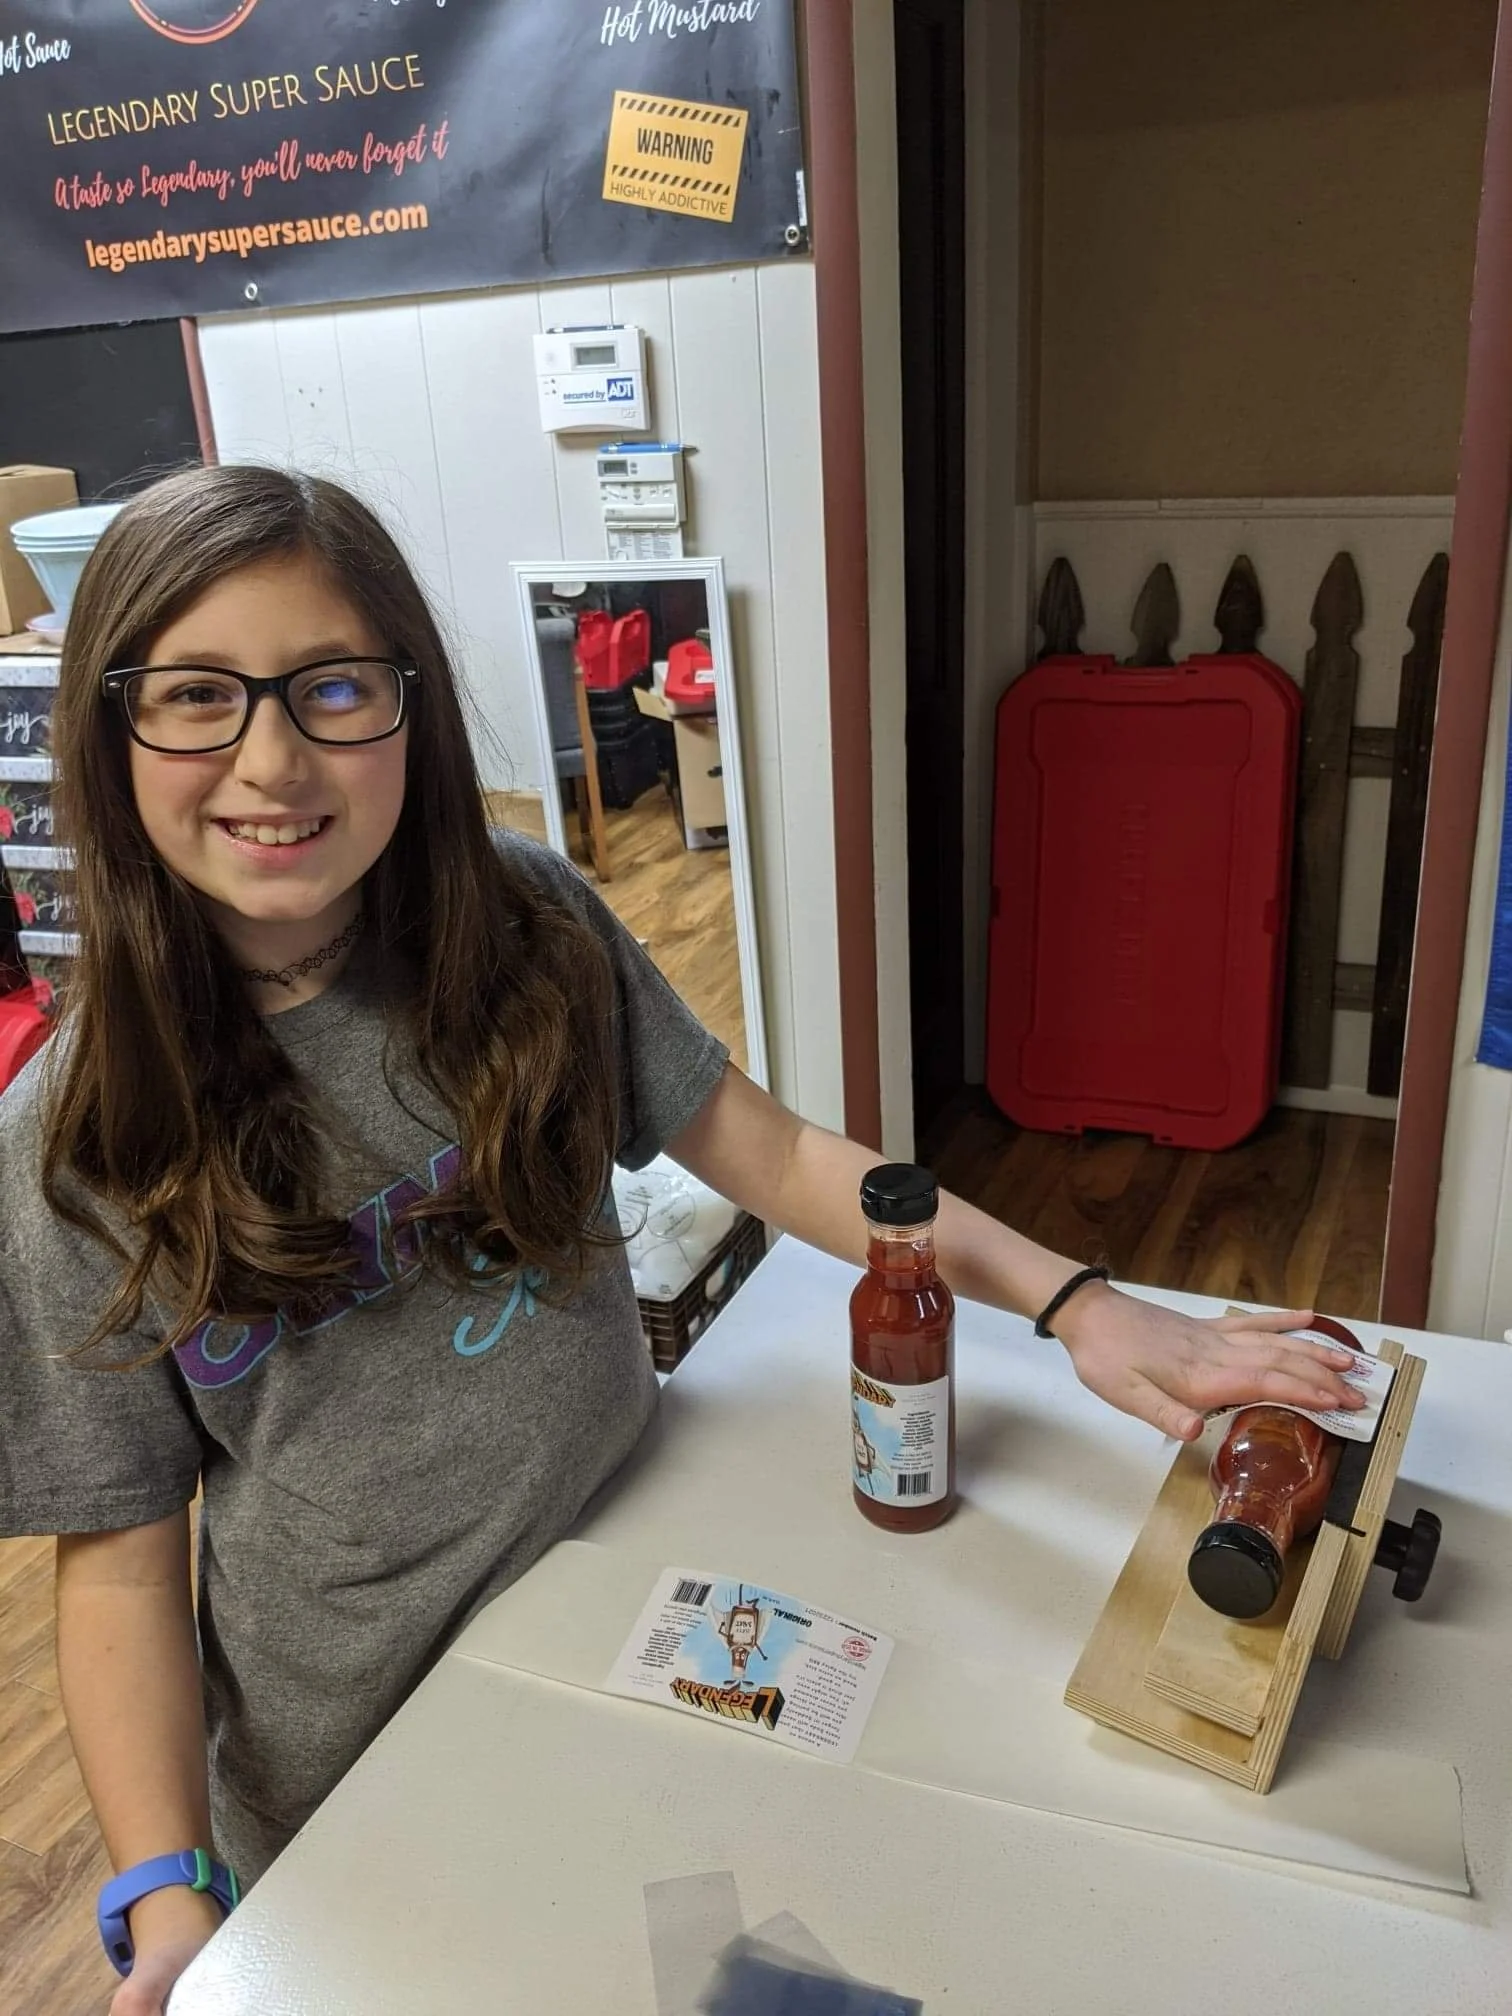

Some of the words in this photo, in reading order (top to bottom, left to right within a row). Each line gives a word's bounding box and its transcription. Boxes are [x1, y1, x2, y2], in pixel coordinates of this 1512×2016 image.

[600, 0, 643, 46] Hot
[648, 0, 761, 39] Mustard
[25, 31, 71, 68] Sauce
[47, 90, 199, 146] LEGENDARY
[210, 74, 307, 119] SUPER
[314, 54, 425, 102] SAUCE
[54, 177, 69, 208] A
[69, 174, 112, 210] taste
[116, 180, 135, 204] so
[140, 160, 235, 206] Legendary,
[240, 139, 301, 197] you'll
[305, 148, 358, 173] never
[363, 123, 427, 175] forget
[430, 119, 450, 160] it
[637, 127, 714, 165] WARNING
[610, 181, 656, 201] HIGHLY
[658, 191, 728, 215] ADDICTIVE
[85, 203, 429, 273] legendarysupersauce.com
[563, 390, 595, 400] secured
[596, 390, 605, 400] by
[607, 380, 634, 399] ADT
[773, 1608, 812, 1627] ORIGINAL
[670, 1676, 785, 1731] LEGENDARY
